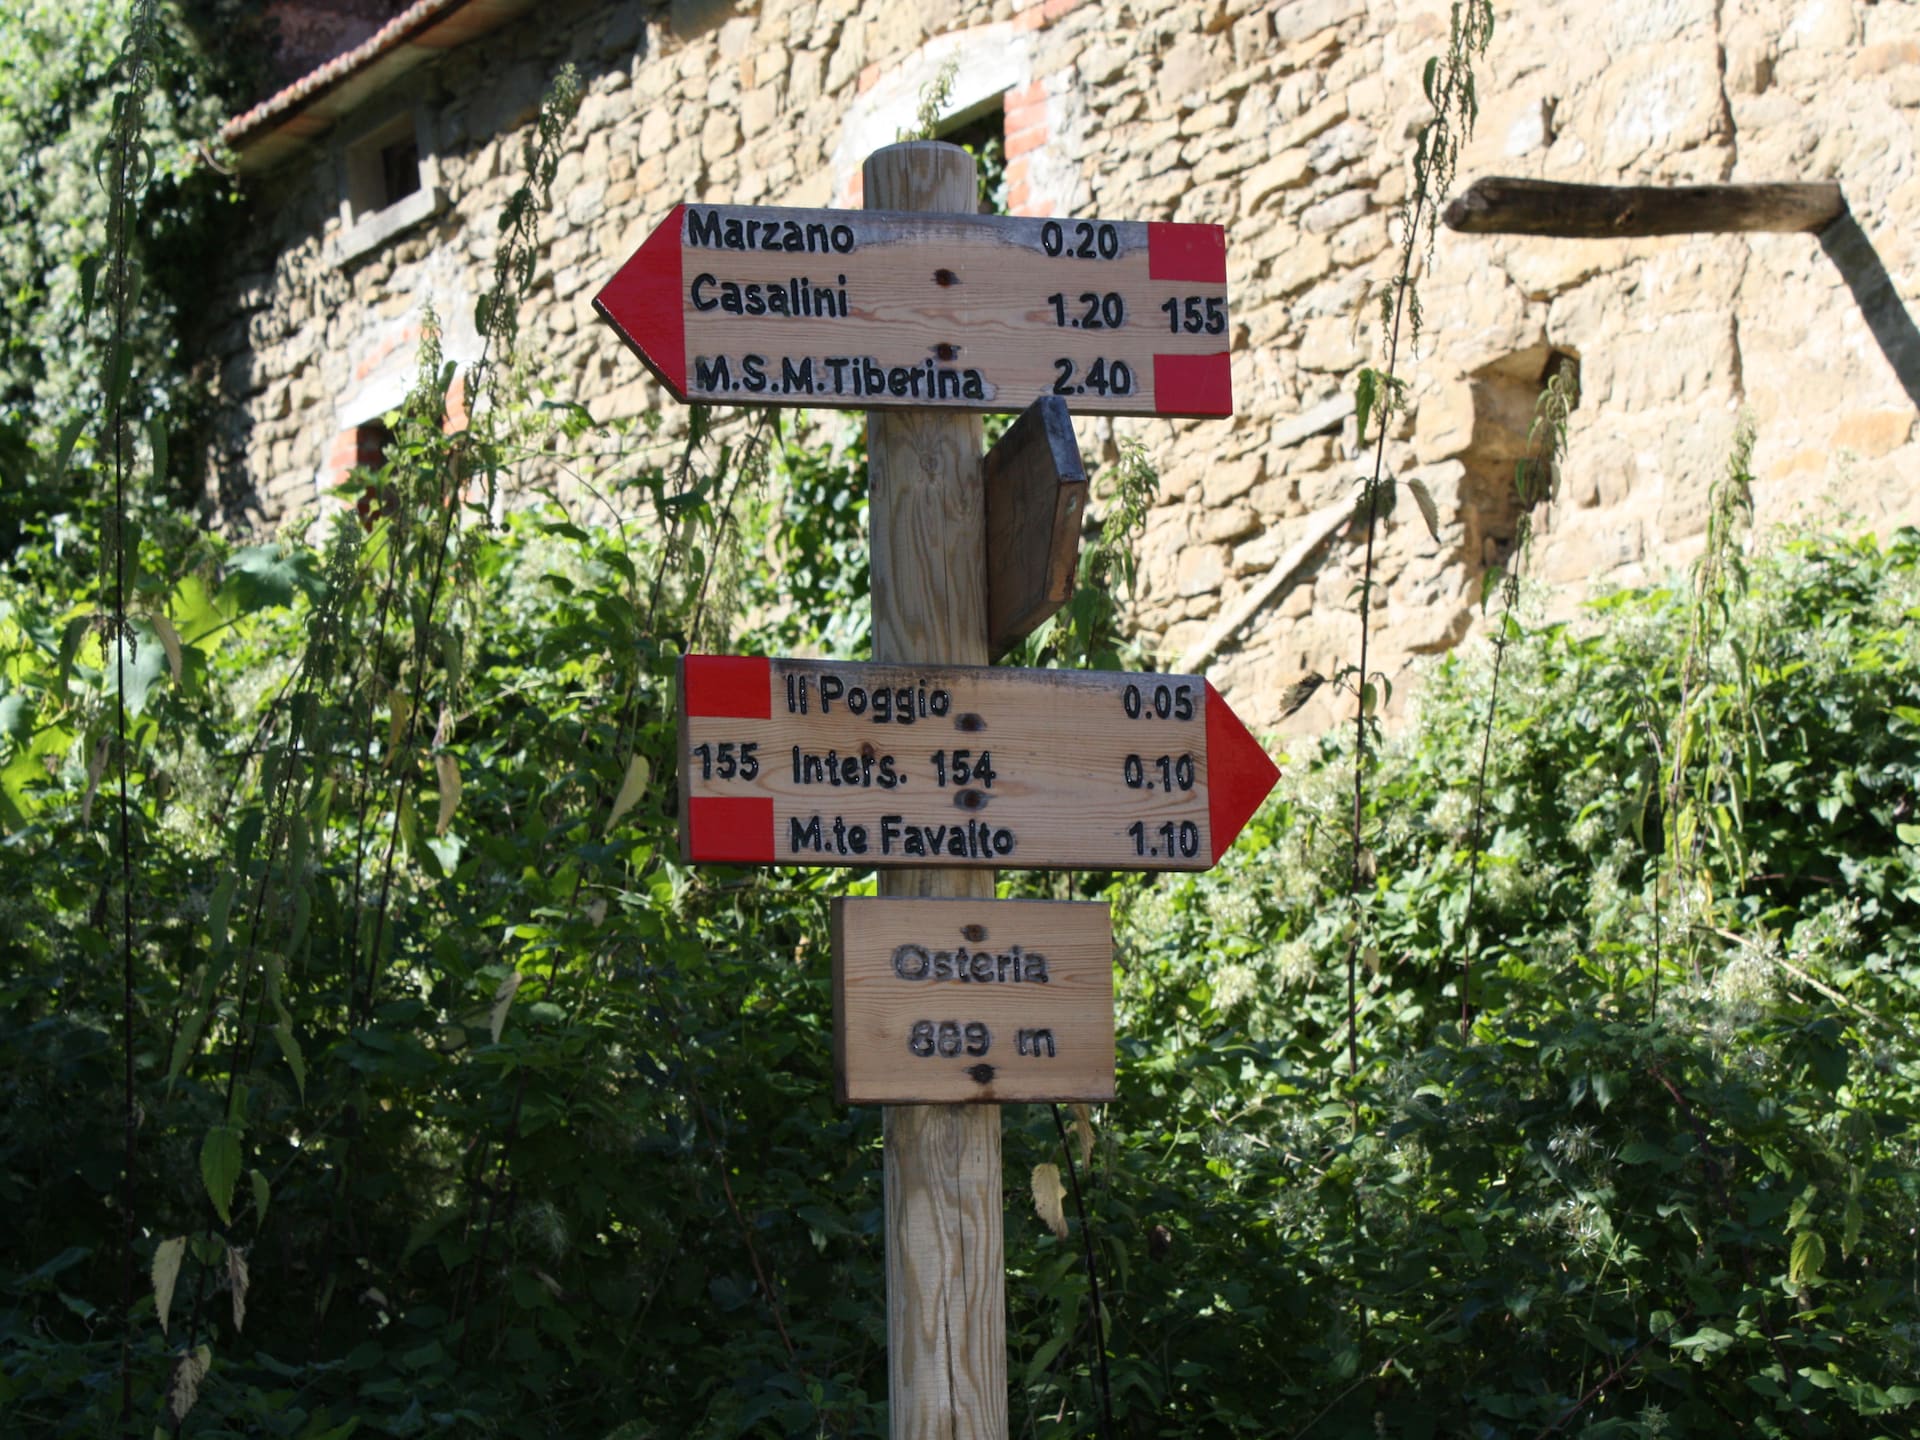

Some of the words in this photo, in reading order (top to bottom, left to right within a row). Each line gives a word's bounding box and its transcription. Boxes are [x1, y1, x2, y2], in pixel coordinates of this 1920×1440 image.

[687, 208, 854, 253] Marzano
[1041, 221, 1119, 259] 0.20
[691, 273, 848, 317] Casalini
[1048, 292, 1123, 329] 1.20
[1162, 296, 1226, 334] 155
[1052, 357, 1131, 395] 2.40
[786, 674, 808, 714] Il
[819, 675, 950, 724] Poggio
[1123, 684, 1193, 720] 0.05
[694, 742, 759, 780] 155
[792, 745, 907, 788] Inters.
[931, 750, 996, 788] 154
[1124, 754, 1195, 792] 0.10
[790, 815, 867, 855] M.te
[881, 815, 1014, 858] Favalto
[1128, 820, 1199, 857] 1.10
[892, 943, 1049, 983] Osteria
[909, 1019, 991, 1058] 889
[1017, 1027, 1056, 1058] m
